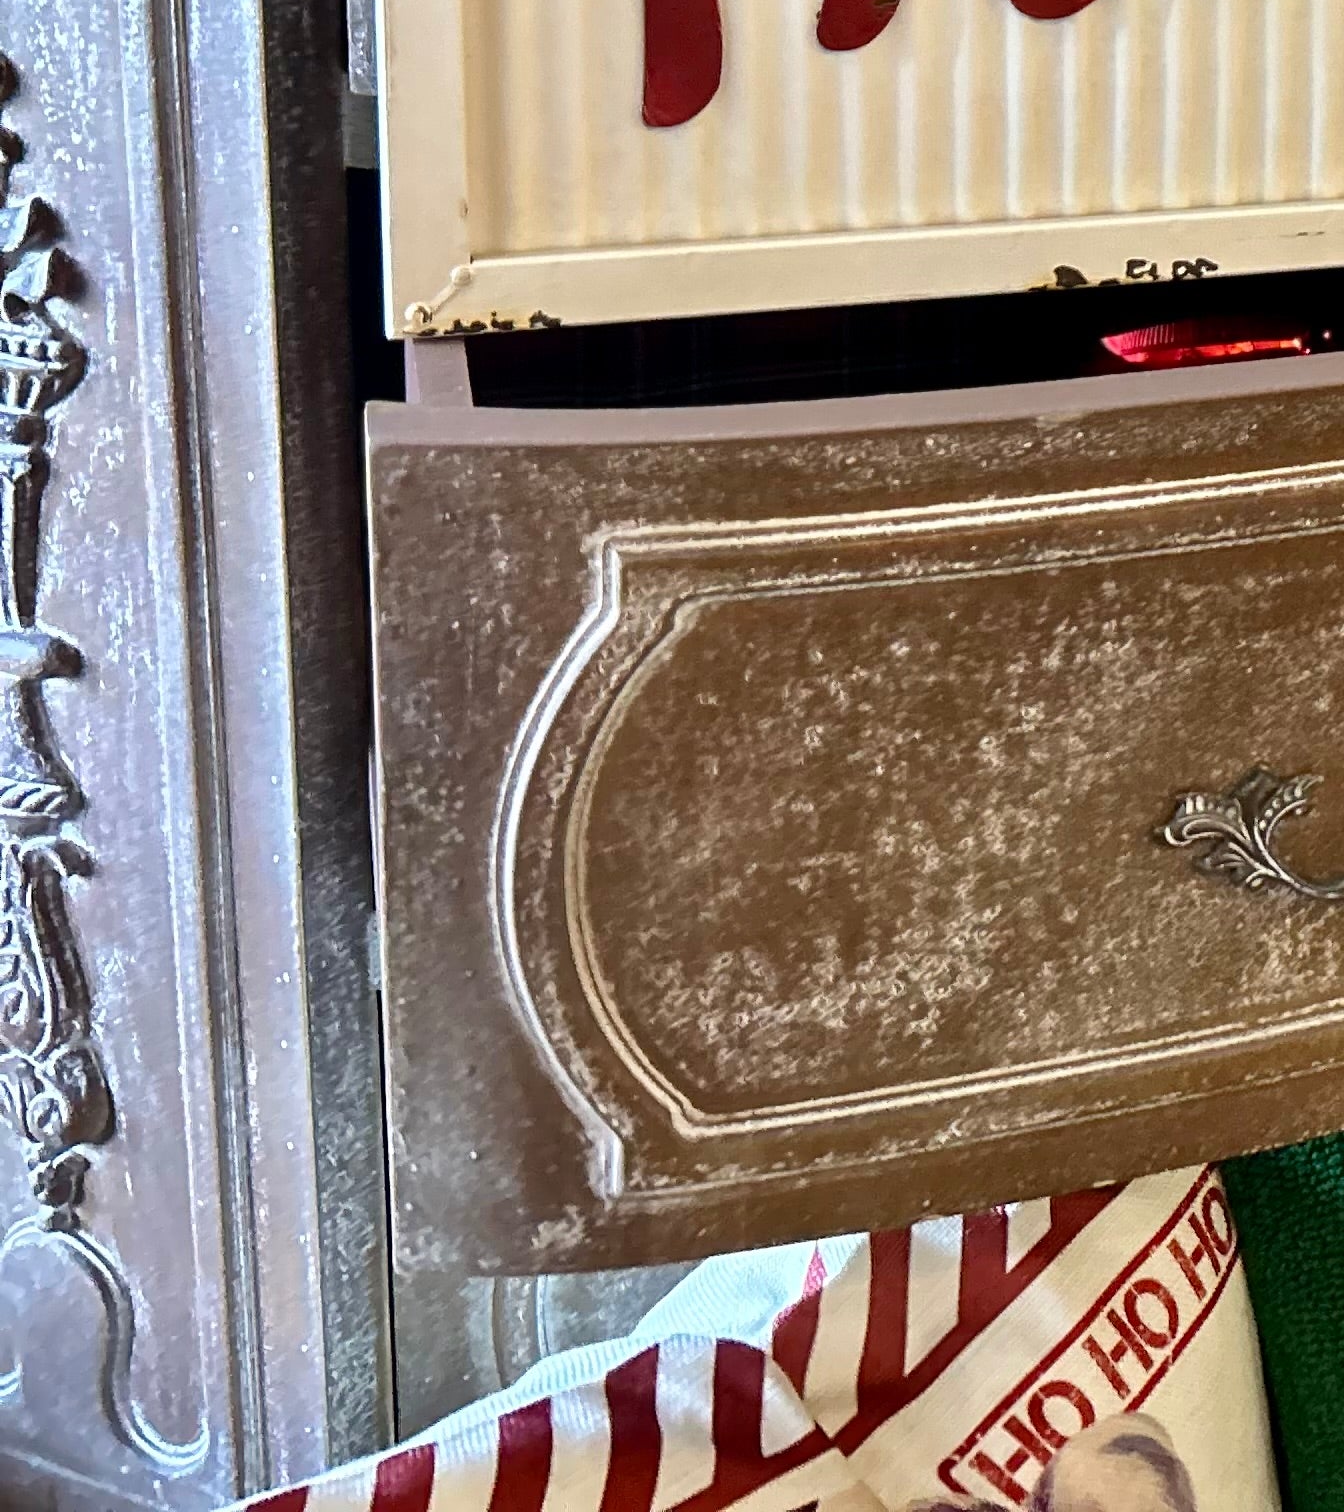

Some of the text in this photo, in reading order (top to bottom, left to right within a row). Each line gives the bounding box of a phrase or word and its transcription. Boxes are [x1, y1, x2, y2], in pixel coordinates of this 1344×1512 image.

[969, 1185, 1234, 1505] HO HO HO
